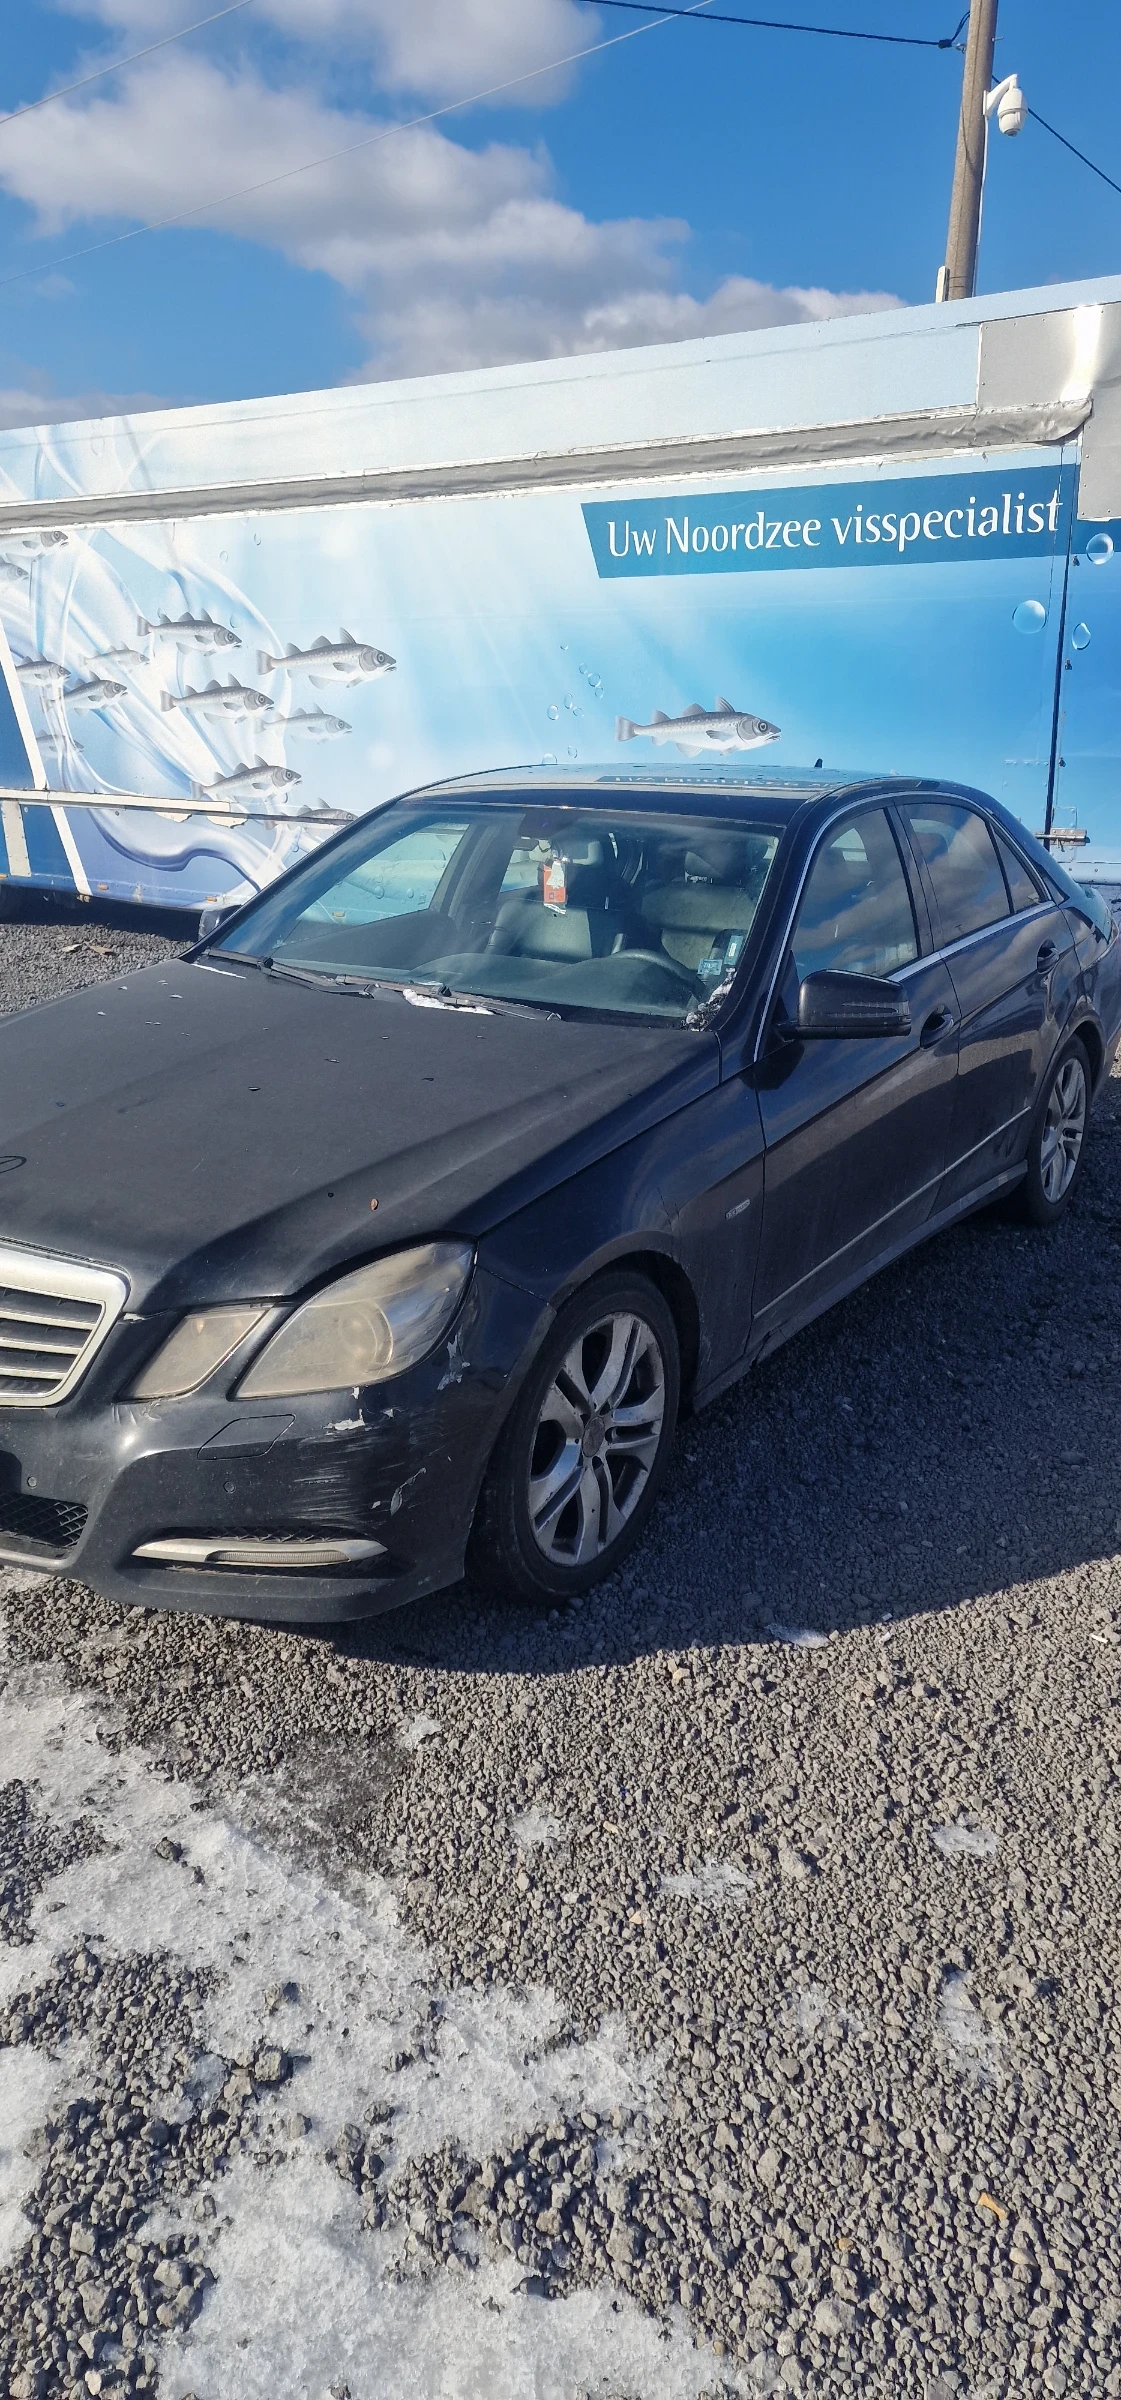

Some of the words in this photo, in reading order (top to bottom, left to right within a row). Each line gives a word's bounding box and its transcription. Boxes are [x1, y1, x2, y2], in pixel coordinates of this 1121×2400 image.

[606, 520, 657, 557] Uw
[664, 511, 822, 555] Noordzee
[830, 489, 1063, 552] visspecialist
